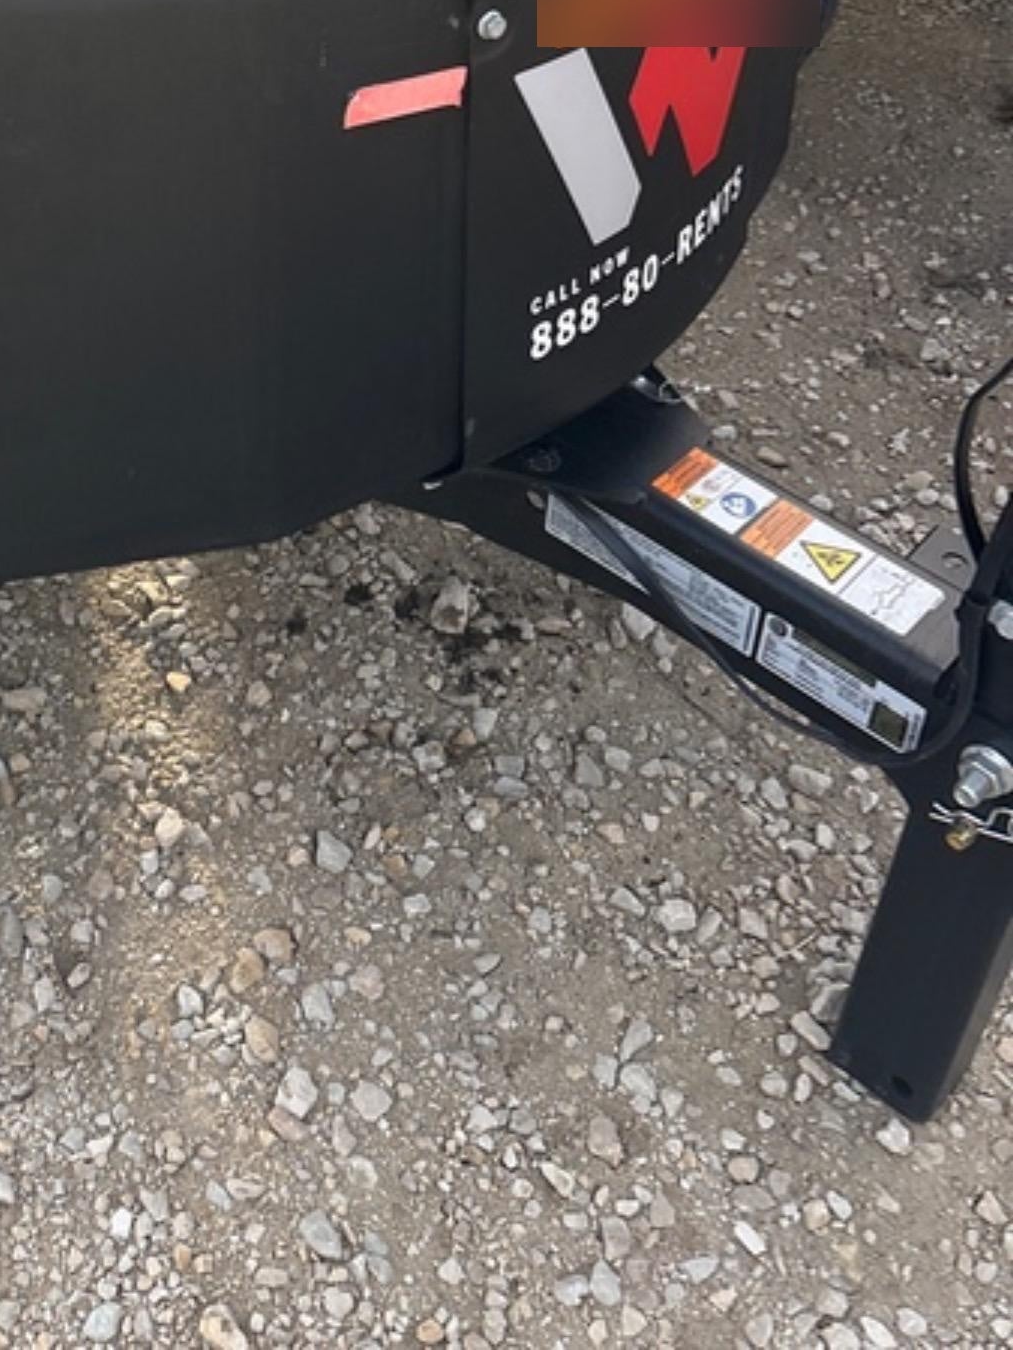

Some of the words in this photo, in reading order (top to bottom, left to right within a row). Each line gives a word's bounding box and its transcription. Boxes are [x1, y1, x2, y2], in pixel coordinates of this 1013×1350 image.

[529, 164, 744, 361] 888-80-RENTS
[529, 278, 582, 316] CALL
[590, 246, 631, 285] NOW
